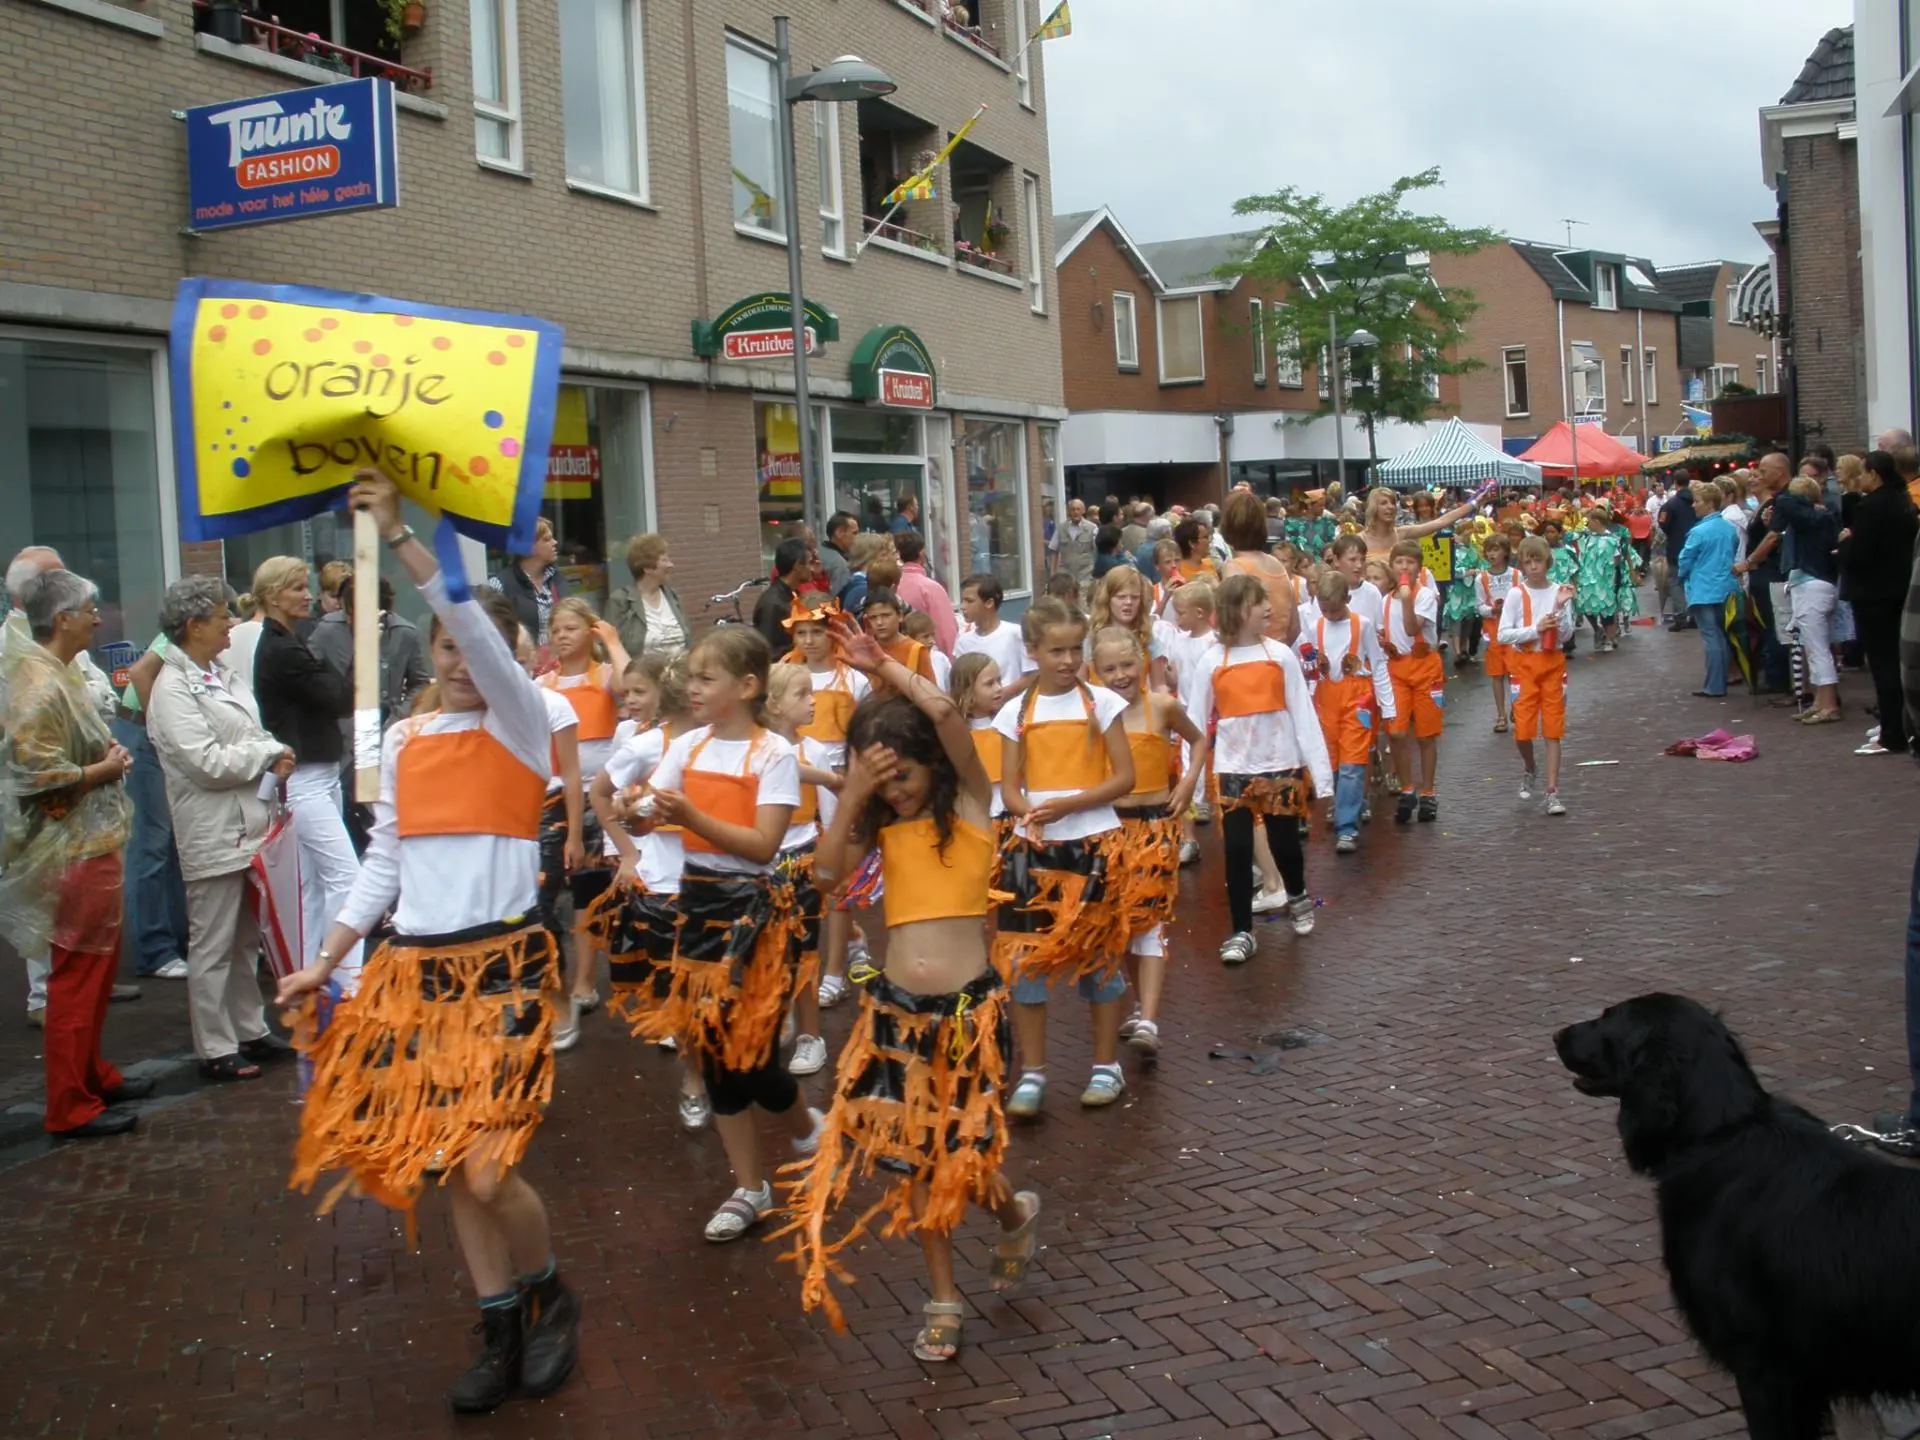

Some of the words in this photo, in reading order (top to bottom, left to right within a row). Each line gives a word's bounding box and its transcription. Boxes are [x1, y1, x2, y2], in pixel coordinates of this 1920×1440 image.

[208, 97, 352, 168] Tuunte
[246, 152, 331, 181] FASHION
[195, 203, 234, 219] mode
[238, 199, 269, 213] voor
[272, 192, 294, 208] het
[334, 181, 371, 203] gezin
[737, 335, 795, 354] Kruidva
[264, 354, 454, 420] oranje
[1573, 415, 1602, 424] EEMAN
[286, 436, 444, 490] boven
[767, 455, 801, 477] Kruidva
